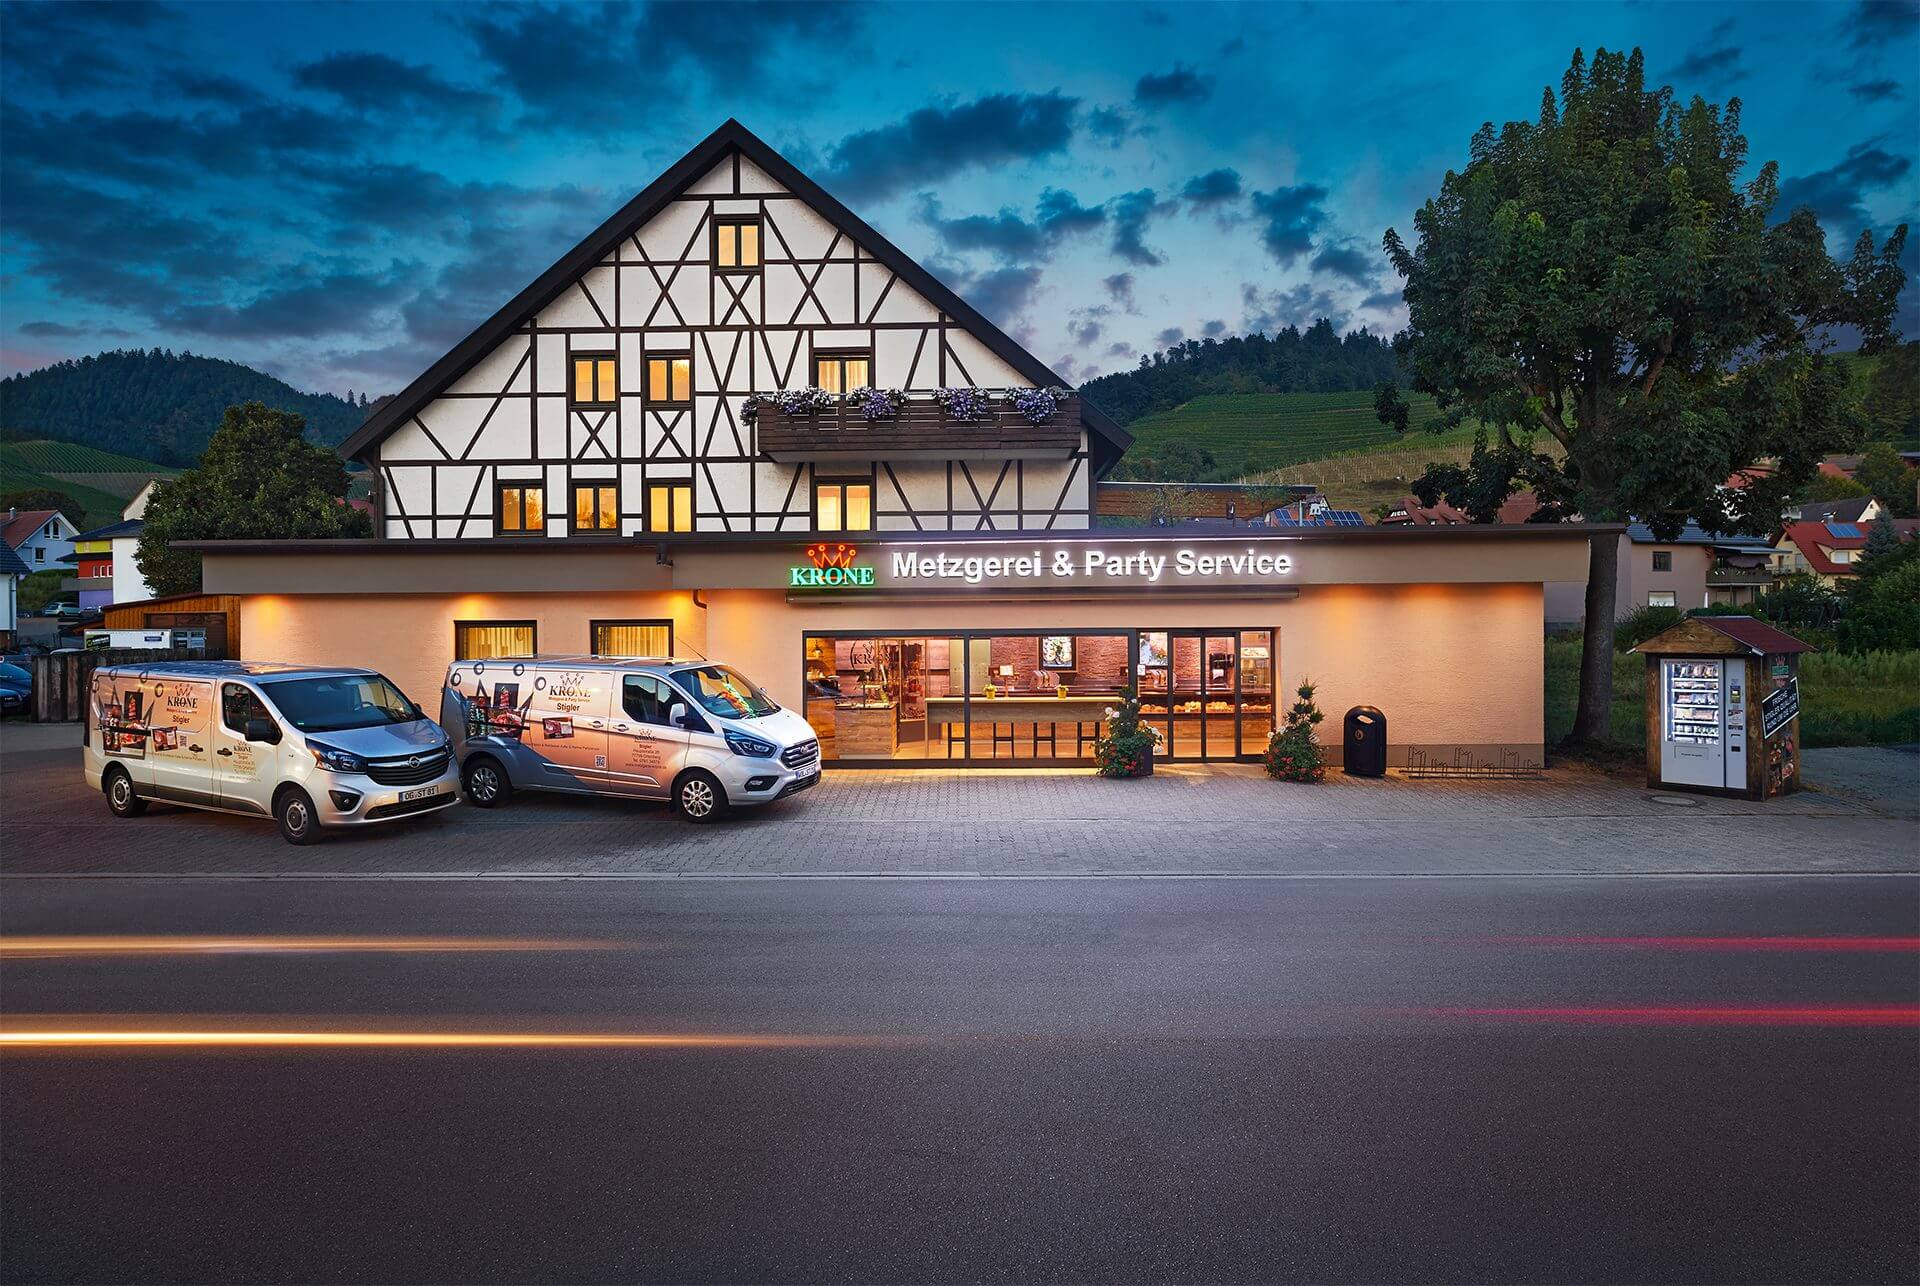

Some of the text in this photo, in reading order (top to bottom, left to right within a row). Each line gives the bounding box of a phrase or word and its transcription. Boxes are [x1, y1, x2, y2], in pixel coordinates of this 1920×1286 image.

[893, 549, 1292, 583] Metzgerei & Party Service
[790, 567, 875, 586] KRONE
[549, 685, 591, 698] KRONE
[167, 695, 198, 709] KRONE
[556, 702, 580, 713] Stigler
